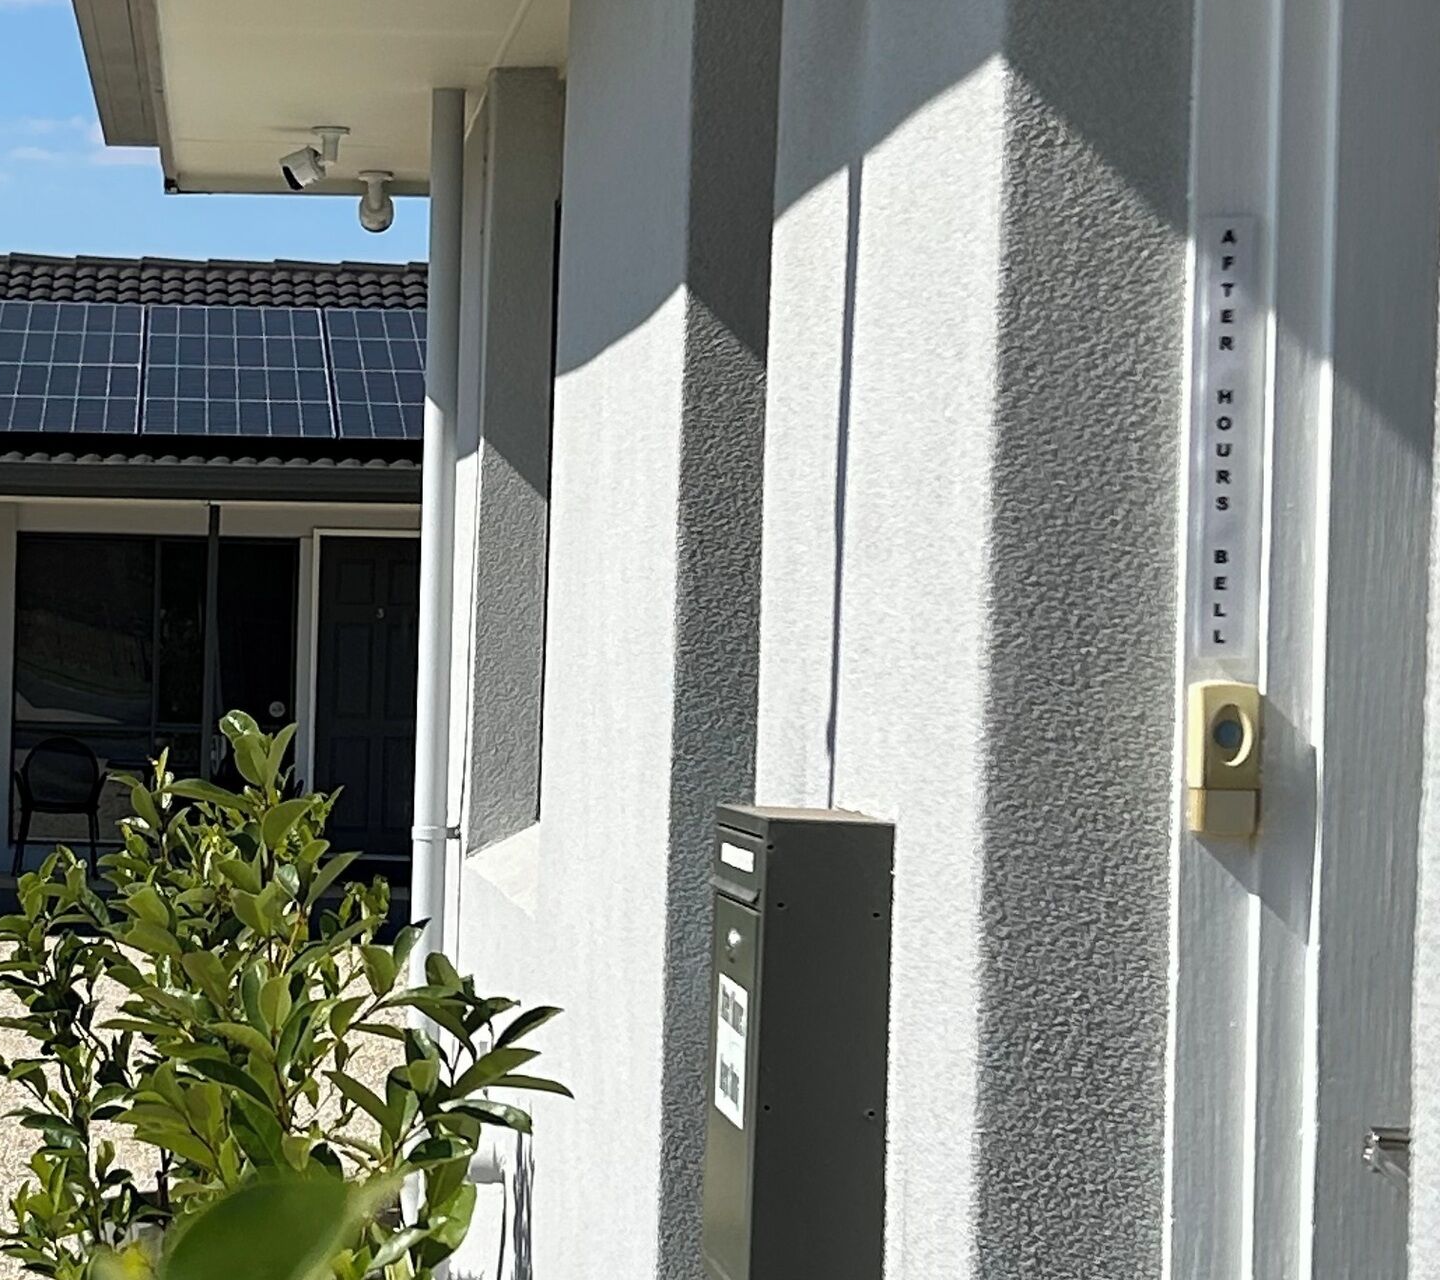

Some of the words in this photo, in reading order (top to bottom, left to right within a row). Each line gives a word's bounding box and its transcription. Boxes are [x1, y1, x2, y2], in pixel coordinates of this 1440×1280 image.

[1219, 228, 1238, 352] AFTER
[1215, 389, 1235, 512] HOURS
[1213, 548, 1230, 645] BELL
